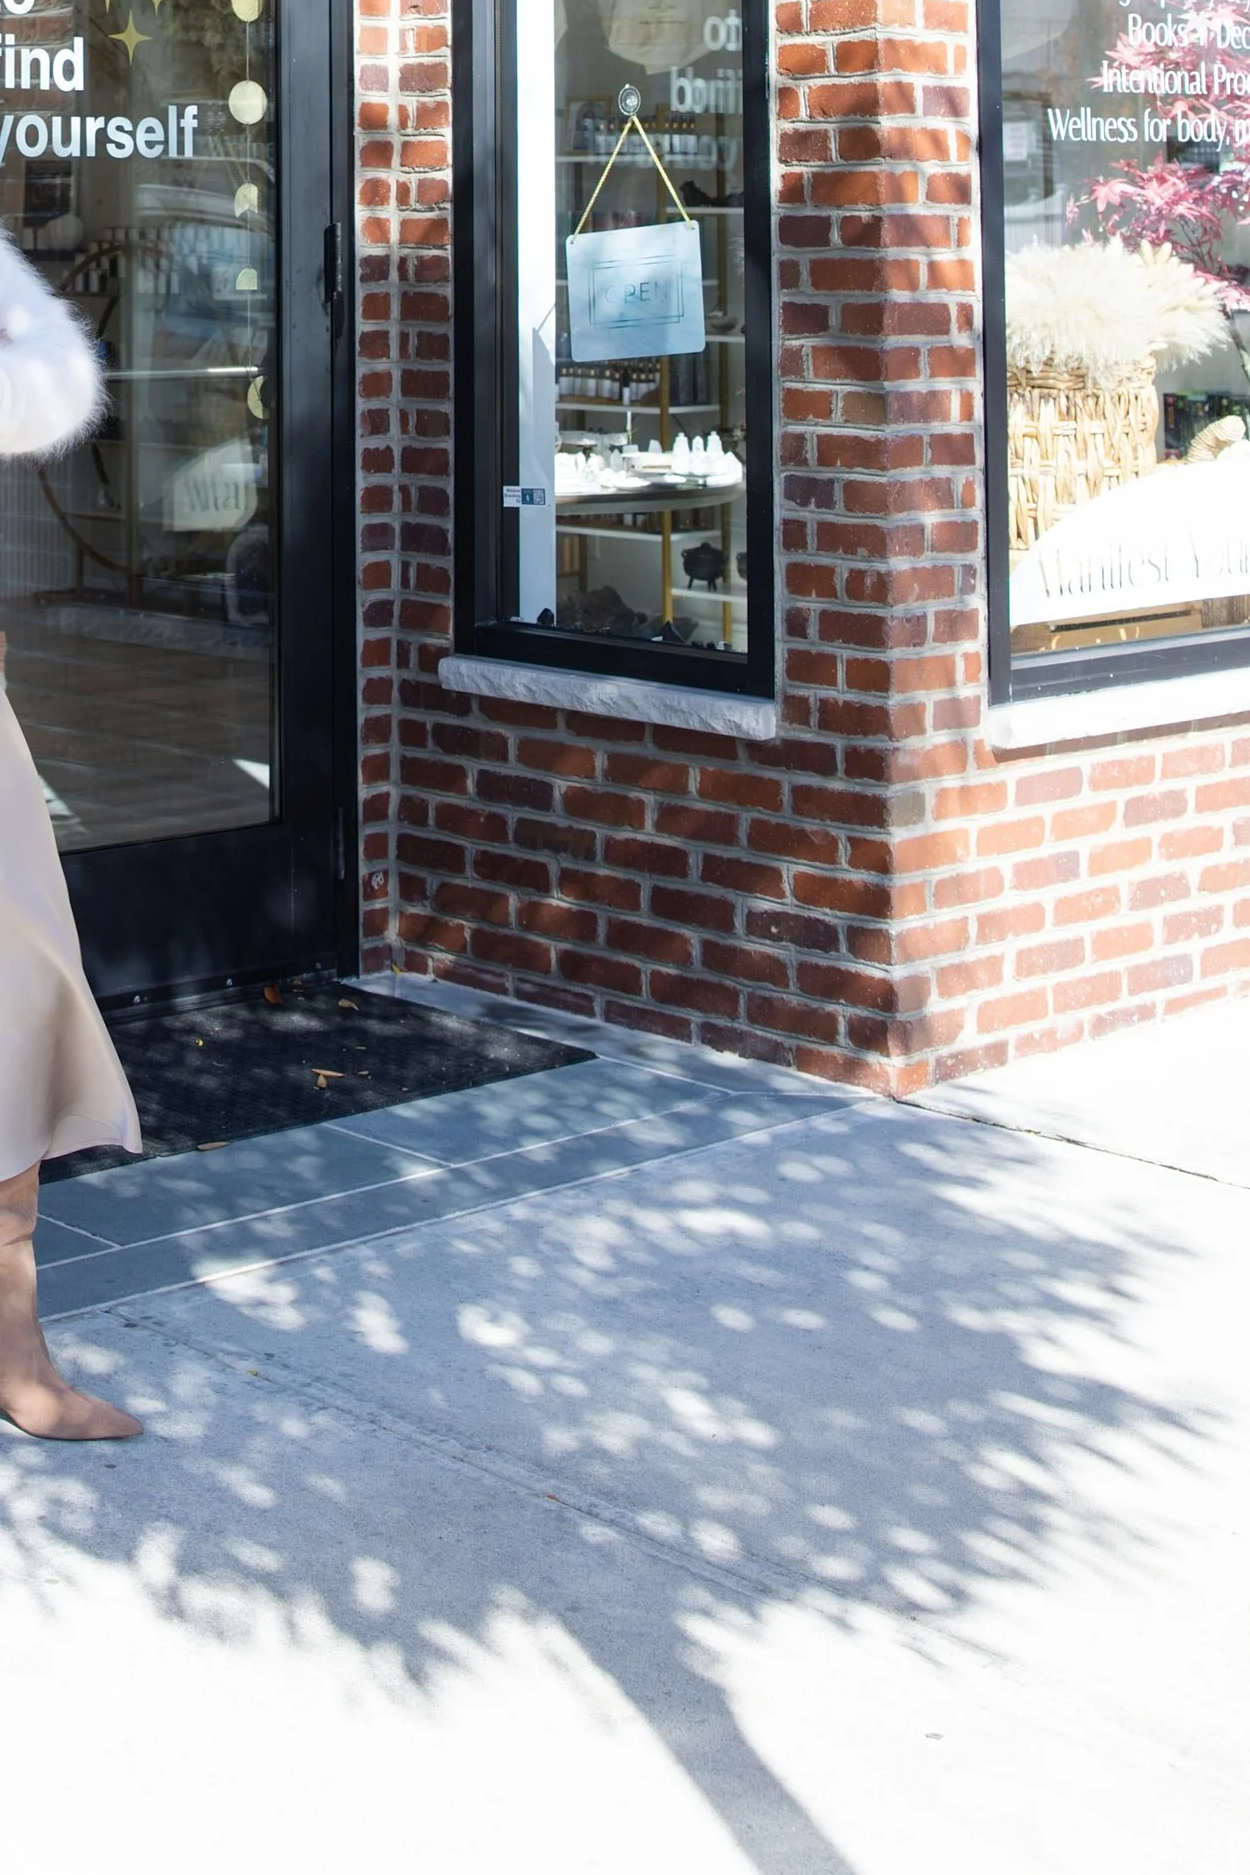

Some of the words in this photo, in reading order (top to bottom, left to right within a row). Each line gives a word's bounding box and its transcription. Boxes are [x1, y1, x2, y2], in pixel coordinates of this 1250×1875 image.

[1128, 13, 1187, 47] Books
[1102, 60, 1208, 95] Intentional
[1047, 106, 1139, 144] Wellness
[1144, 108, 1172, 143] for
[1177, 109, 1231, 153] body,
